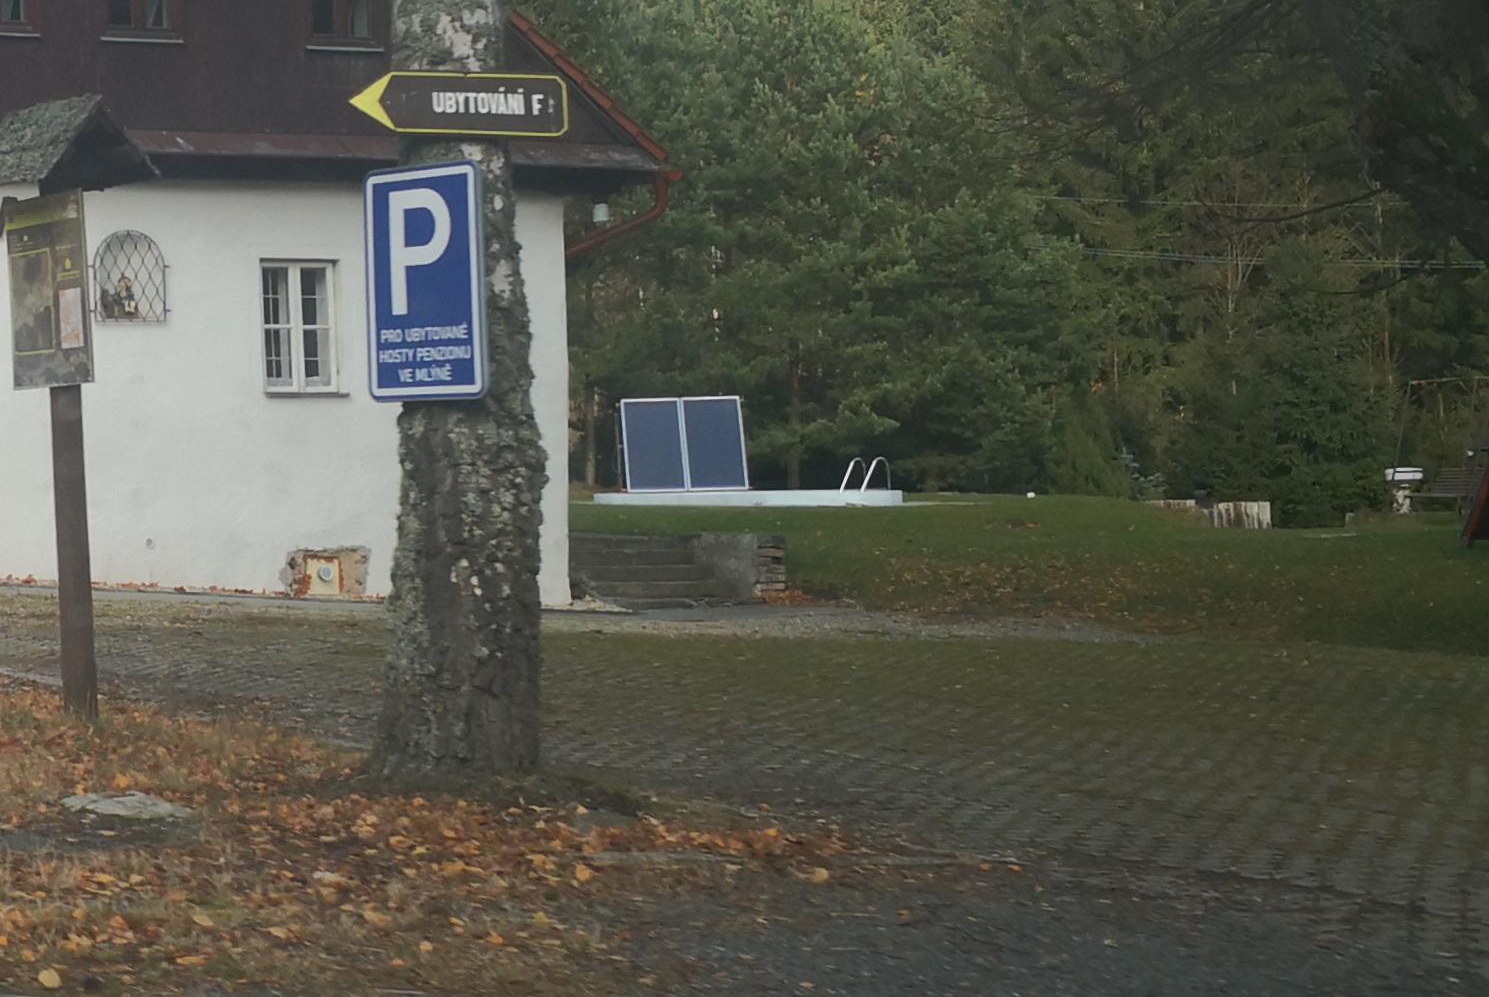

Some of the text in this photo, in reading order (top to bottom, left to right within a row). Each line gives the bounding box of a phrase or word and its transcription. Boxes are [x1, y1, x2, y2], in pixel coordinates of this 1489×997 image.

[388, 187, 452, 316] P
[380, 322, 469, 343] PRO UBYTOVANÉ
[379, 345, 471, 363] HOSTY PENZIONU
[398, 368, 414, 382] VE
